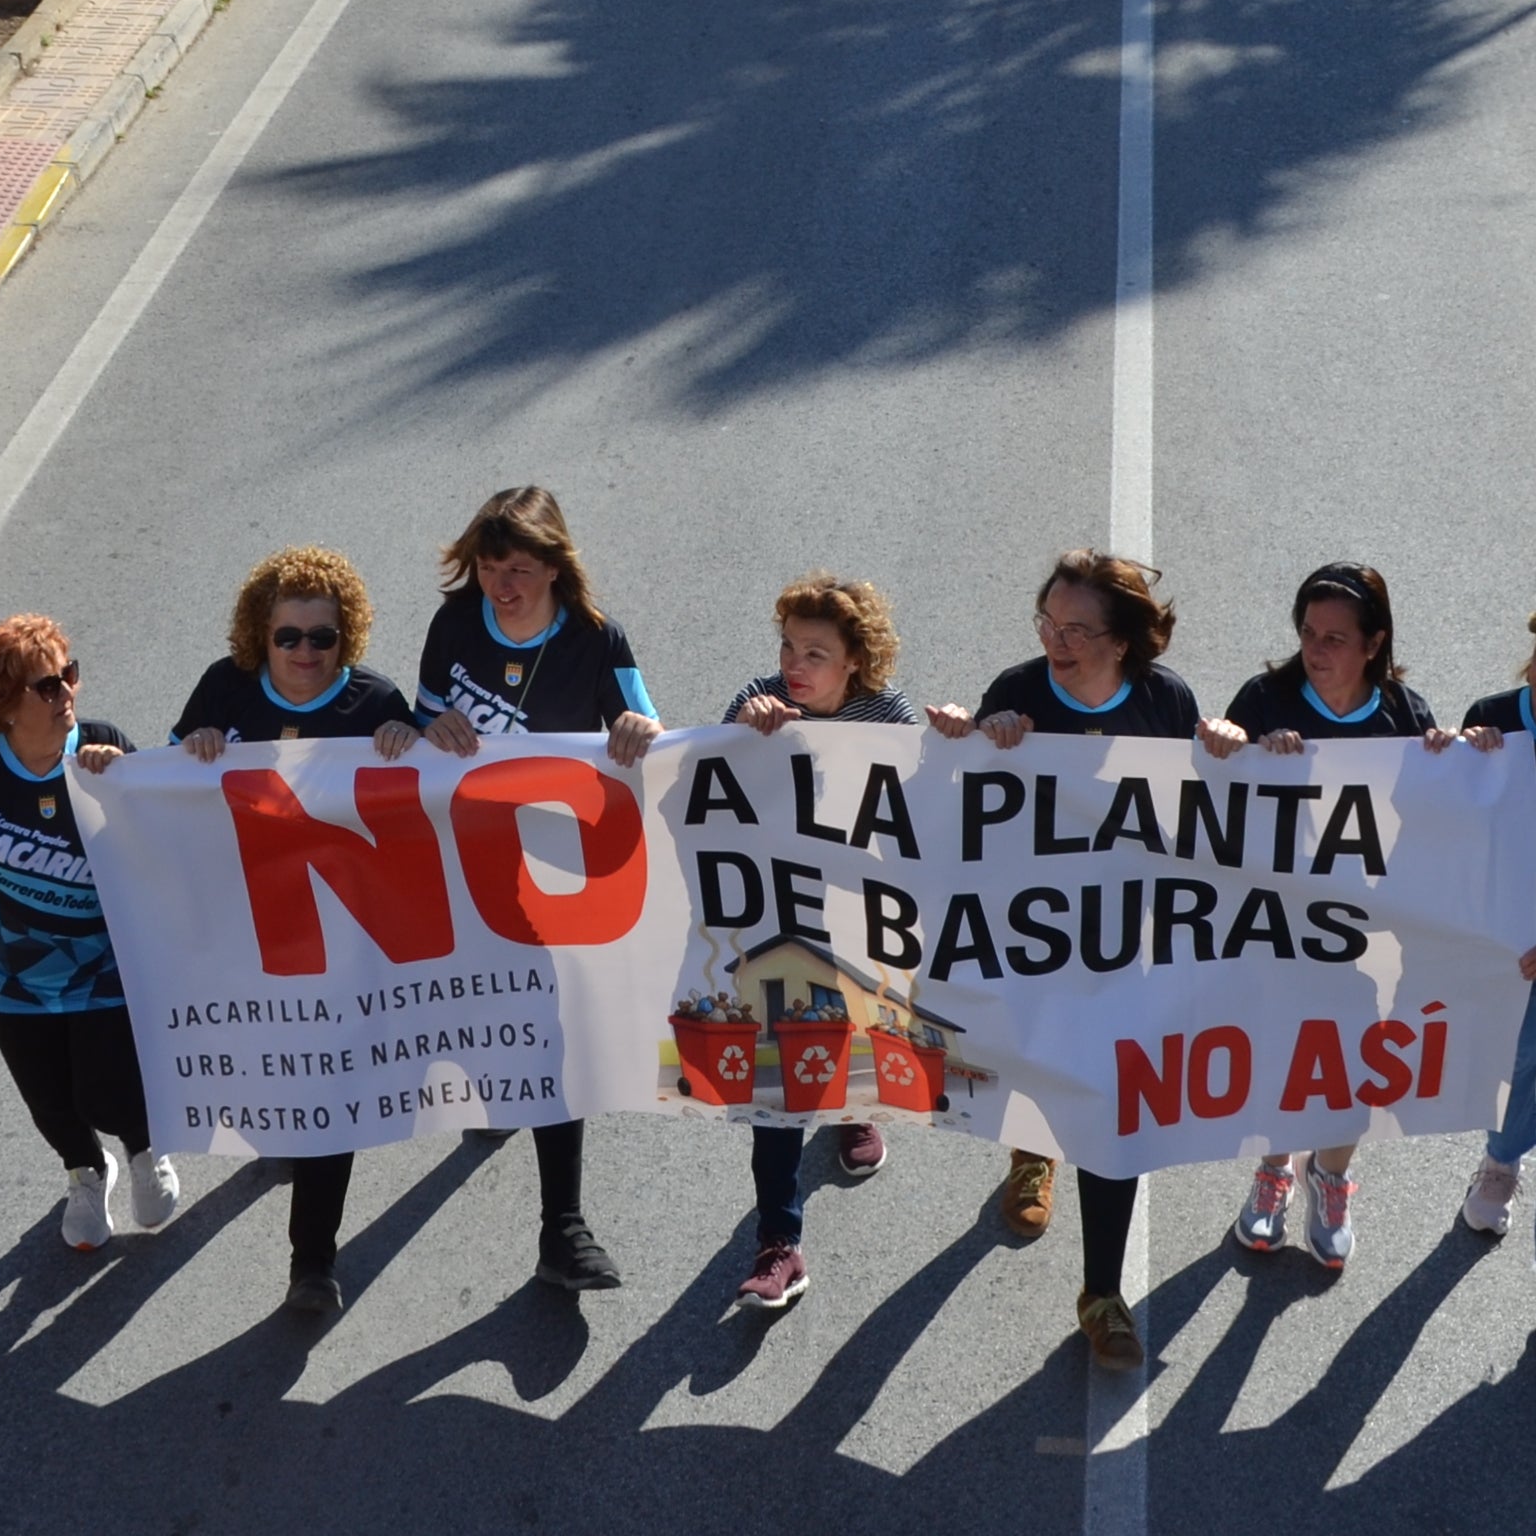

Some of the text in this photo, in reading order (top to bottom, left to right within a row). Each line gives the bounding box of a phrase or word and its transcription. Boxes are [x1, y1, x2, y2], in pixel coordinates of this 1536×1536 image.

[220, 755, 650, 977] NO
[684, 753, 1388, 877] A LA PLANTA
[695, 849, 1370, 982] DE BASURAS
[167, 967, 556, 1030] JACARILLA, VISTABELLA,
[176, 1022, 550, 1079] URB. ENTRE NARANJOS,
[185, 1073, 557, 1131] BIGASTRO Y BENEJÚZAR
[1116, 1000, 1450, 1137] NO ASÍ
